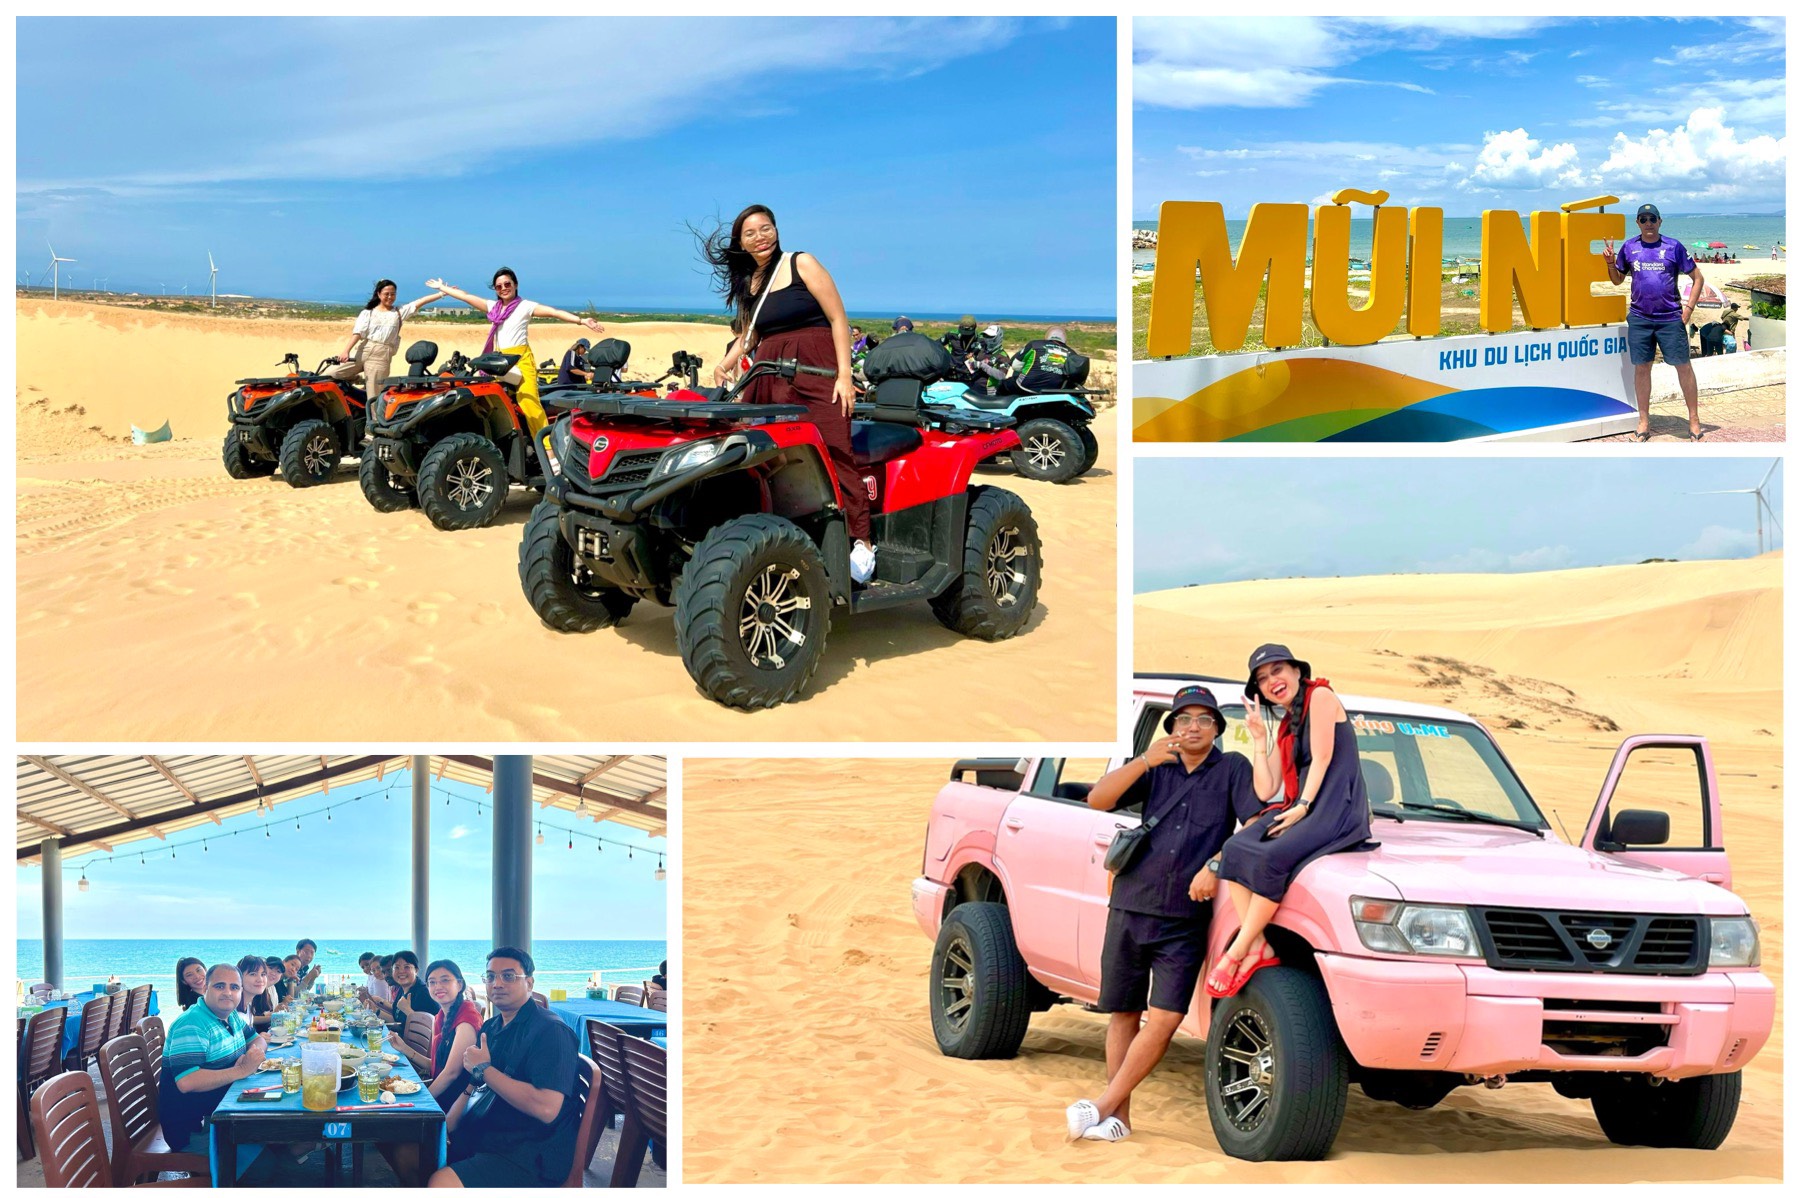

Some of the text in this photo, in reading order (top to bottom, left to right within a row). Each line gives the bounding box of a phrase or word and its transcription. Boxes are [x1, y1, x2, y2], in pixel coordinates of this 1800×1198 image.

[1147, 188, 1627, 358] MŨI NÉ
[1439, 334, 1627, 370] KHU DU LỊCH QUỐC GIA
[327, 1122, 347, 1136] 07
